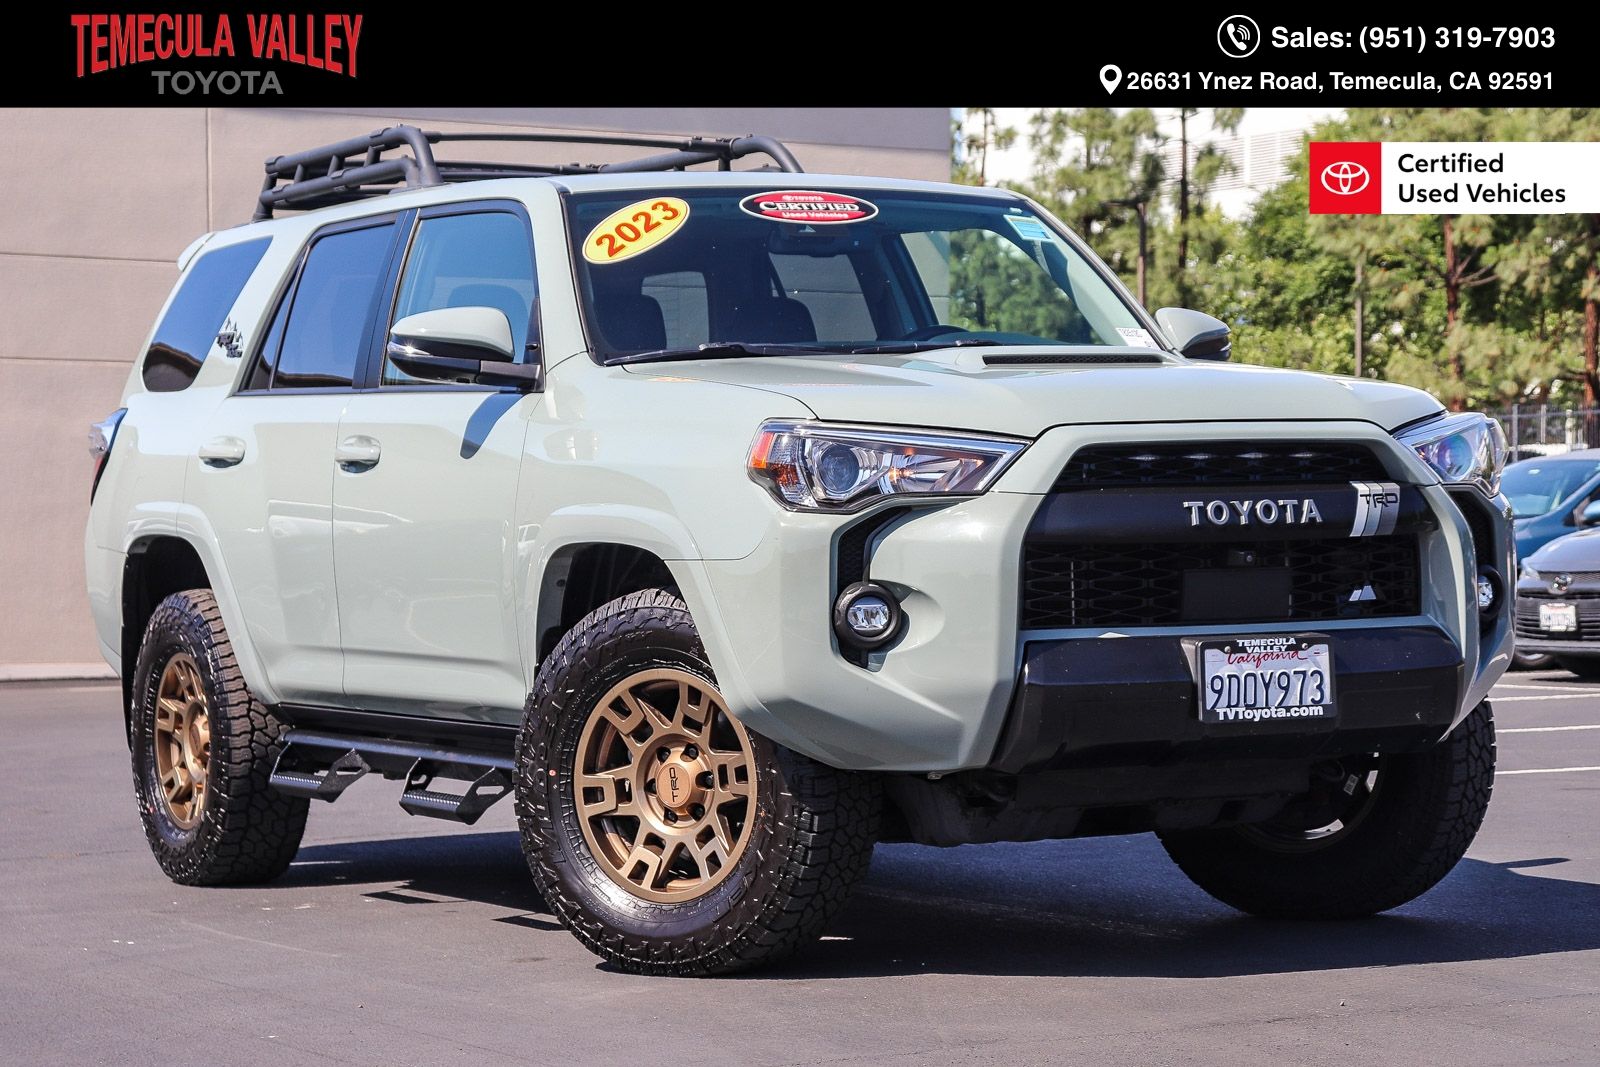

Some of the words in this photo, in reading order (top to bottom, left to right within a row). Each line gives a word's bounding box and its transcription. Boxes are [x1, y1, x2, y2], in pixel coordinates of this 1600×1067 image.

[759, 201, 860, 212] CERTIFIED
[596, 201, 679, 257] 2023
[1360, 492, 1399, 508] TRD
[1183, 499, 1323, 526] TOYOTA
[1236, 638, 1297, 647] TEMECULA
[1246, 645, 1288, 653] VALLEY
[1227, 649, 1308, 669] California
[1216, 705, 1324, 722] TVToyota.com
[669, 767, 679, 803] TRD
